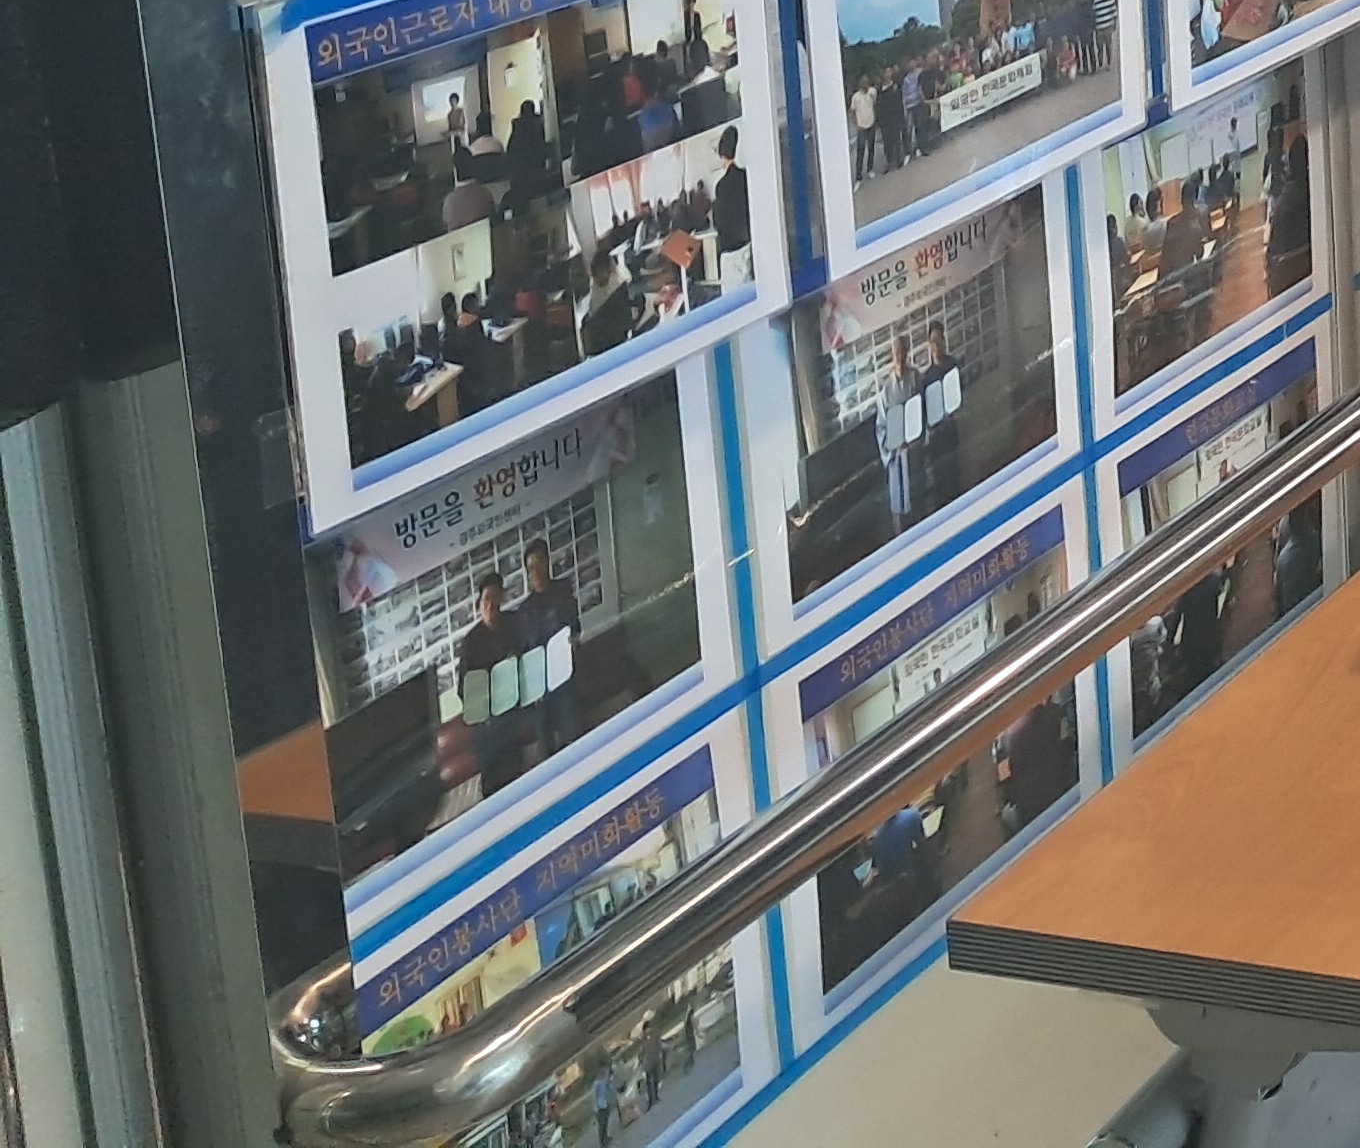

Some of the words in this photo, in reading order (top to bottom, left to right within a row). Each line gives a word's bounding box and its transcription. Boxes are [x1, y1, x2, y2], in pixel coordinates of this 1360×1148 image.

[860, 259, 908, 307] 방문을
[914, 214, 987, 279] 환영합니다
[393, 490, 466, 550] 방문을
[472, 427, 582, 511] 환영합니다
[840, 600, 936, 683] 외국인봉사단
[378, 887, 523, 1008] 외국인봉사단
[536, 787, 667, 893] 지역미화활동
